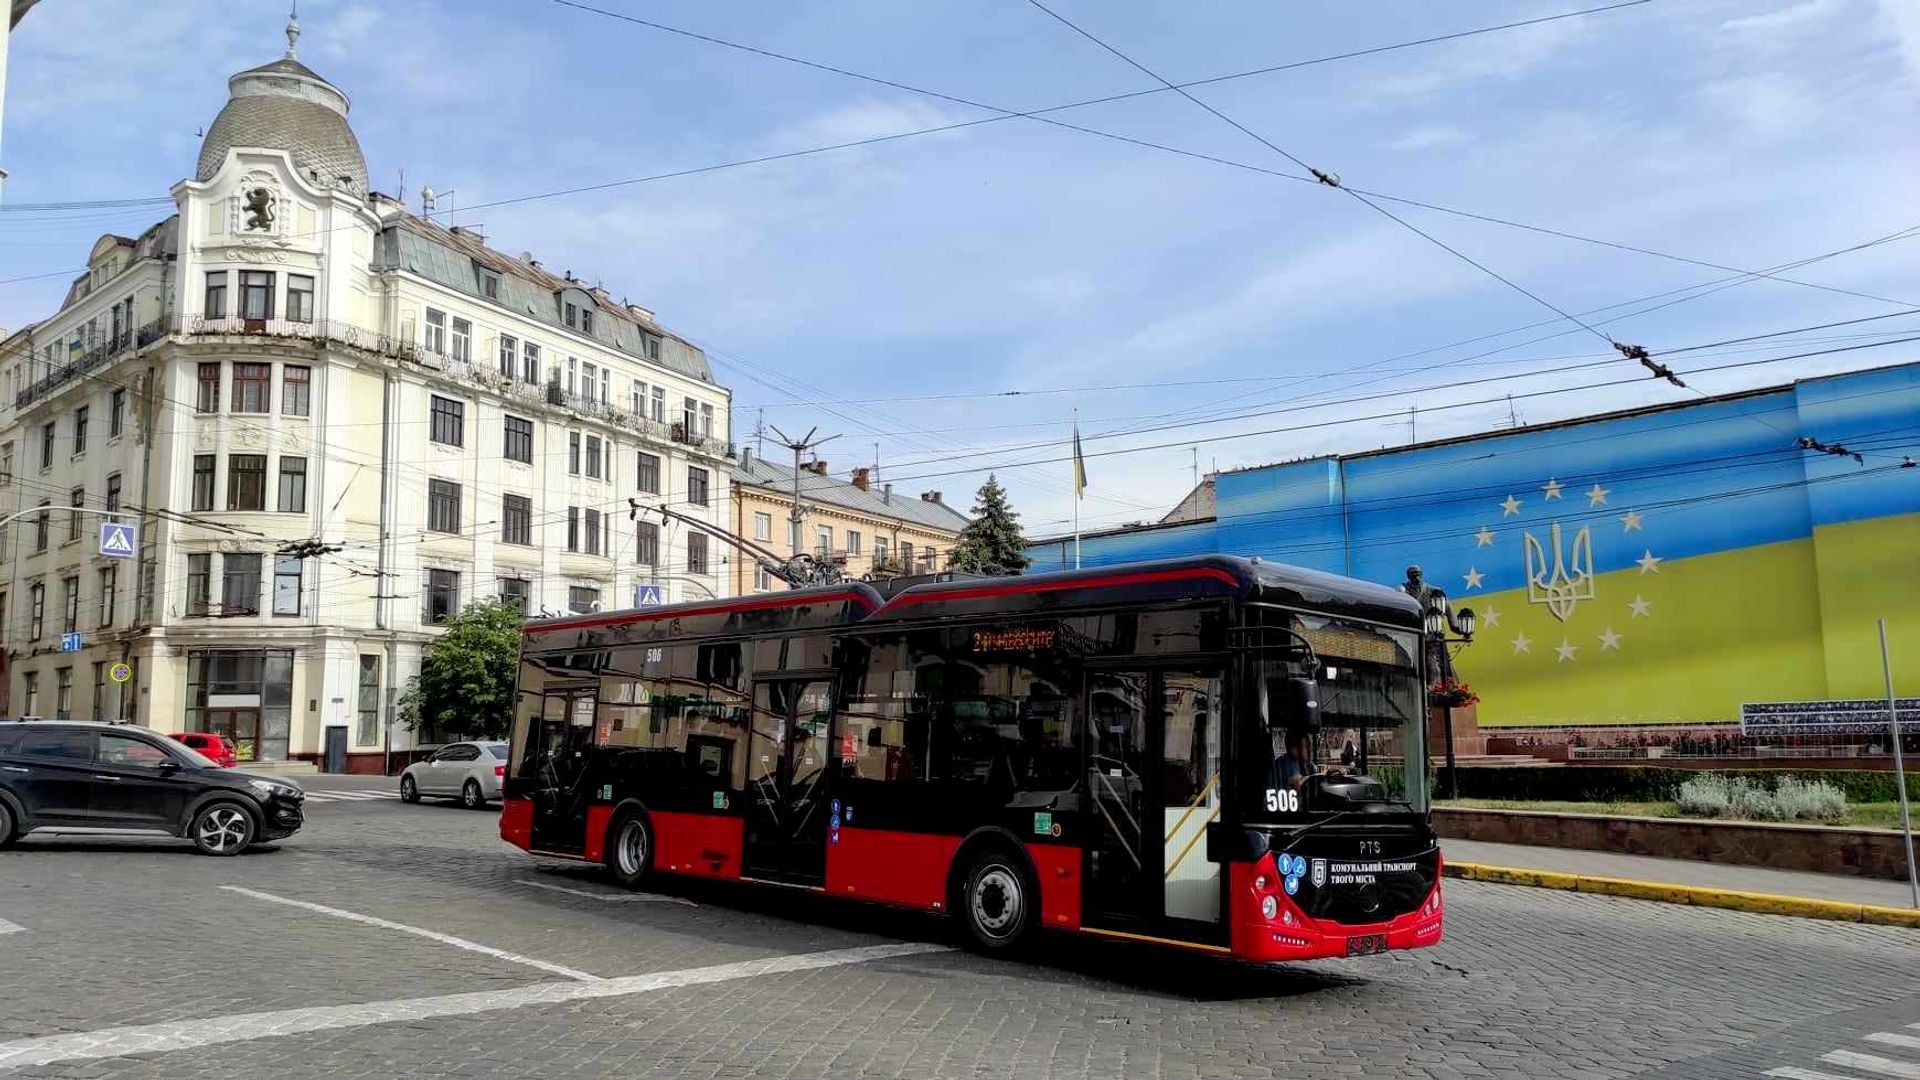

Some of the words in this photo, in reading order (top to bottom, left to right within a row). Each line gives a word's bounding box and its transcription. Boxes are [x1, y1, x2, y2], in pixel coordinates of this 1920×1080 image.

[646, 647, 662, 663] 506
[1265, 788, 1299, 812] 506
[1359, 840, 1381, 855] PTS
[1330, 861, 1382, 873] КОМУНАЛЬНИЙ
[1383, 862, 1417, 872] ТРАНСПОРТ
[1330, 874, 1354, 884] ТВОГО
[1355, 874, 1376, 884] МІСТА
